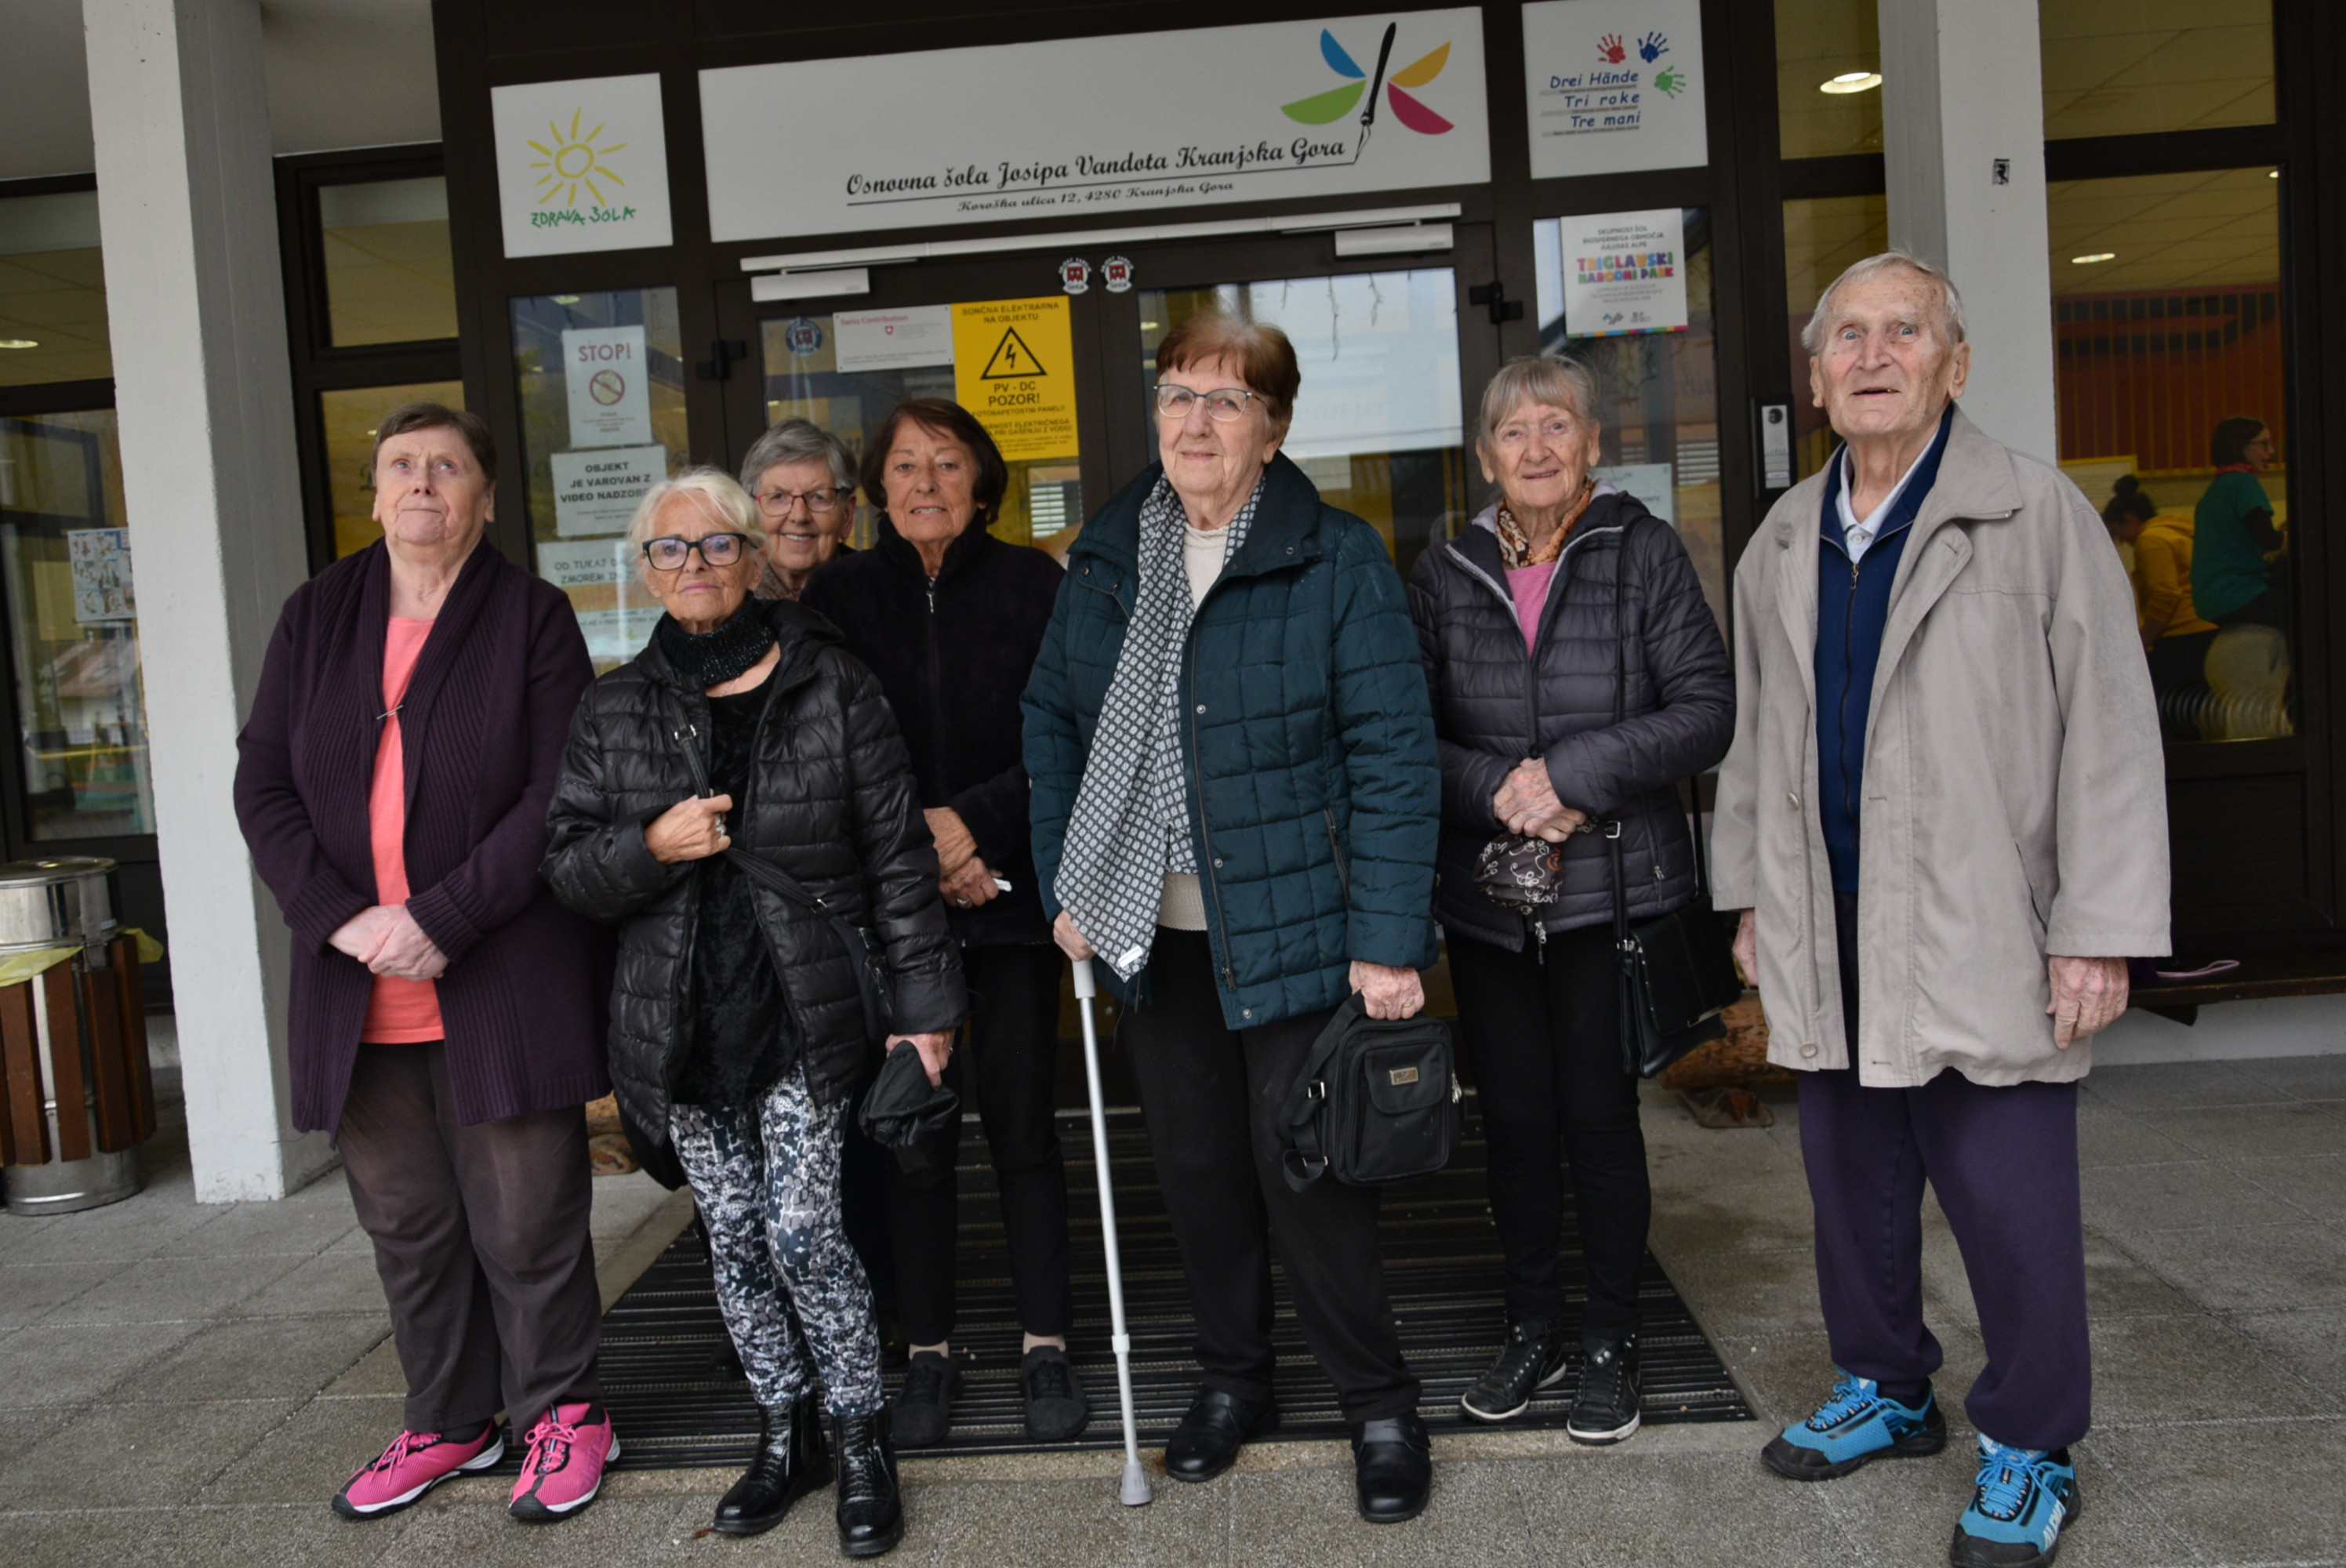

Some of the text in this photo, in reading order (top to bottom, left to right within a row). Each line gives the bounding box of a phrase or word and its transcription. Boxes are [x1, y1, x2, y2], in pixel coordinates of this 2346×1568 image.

[1549, 69, 1640, 89] Drei Hände
[1564, 92, 1640, 108] Tri roke
[1571, 111, 1641, 129] Tre mani
[846, 136, 1346, 196] Osnovna šola Josipa Vandota Kranjska Gora
[957, 181, 1233, 212] Koroška ulica 12, 4280 Kranjska Gora
[530, 209, 585, 229] ZDRAVA
[1577, 251, 1674, 272] TRIGLAVSKI
[1578, 267, 1675, 285] NARODNI PARK
[961, 301, 1059, 315] SONČNA ELEKTRARNA
[861, 314, 909, 325] Contribution
[997, 314, 1039, 323] OBJEKTU
[578, 342, 632, 363] STOP!
[993, 383, 1009, 393] PV
[1019, 381, 1036, 391] DC
[988, 392, 1040, 406] POZOR!
[1014, 418, 1070, 428] ELEKTRIČNEGA
[585, 461, 630, 473] OBJEKT
[570, 474, 652, 488] JE VAROVAN Z
[560, 488, 650, 503] VIDEO NADZORO
[554, 561, 570, 572] OD
[573, 557, 607, 570] TUKAJ
[560, 572, 605, 585] ZMOREM
